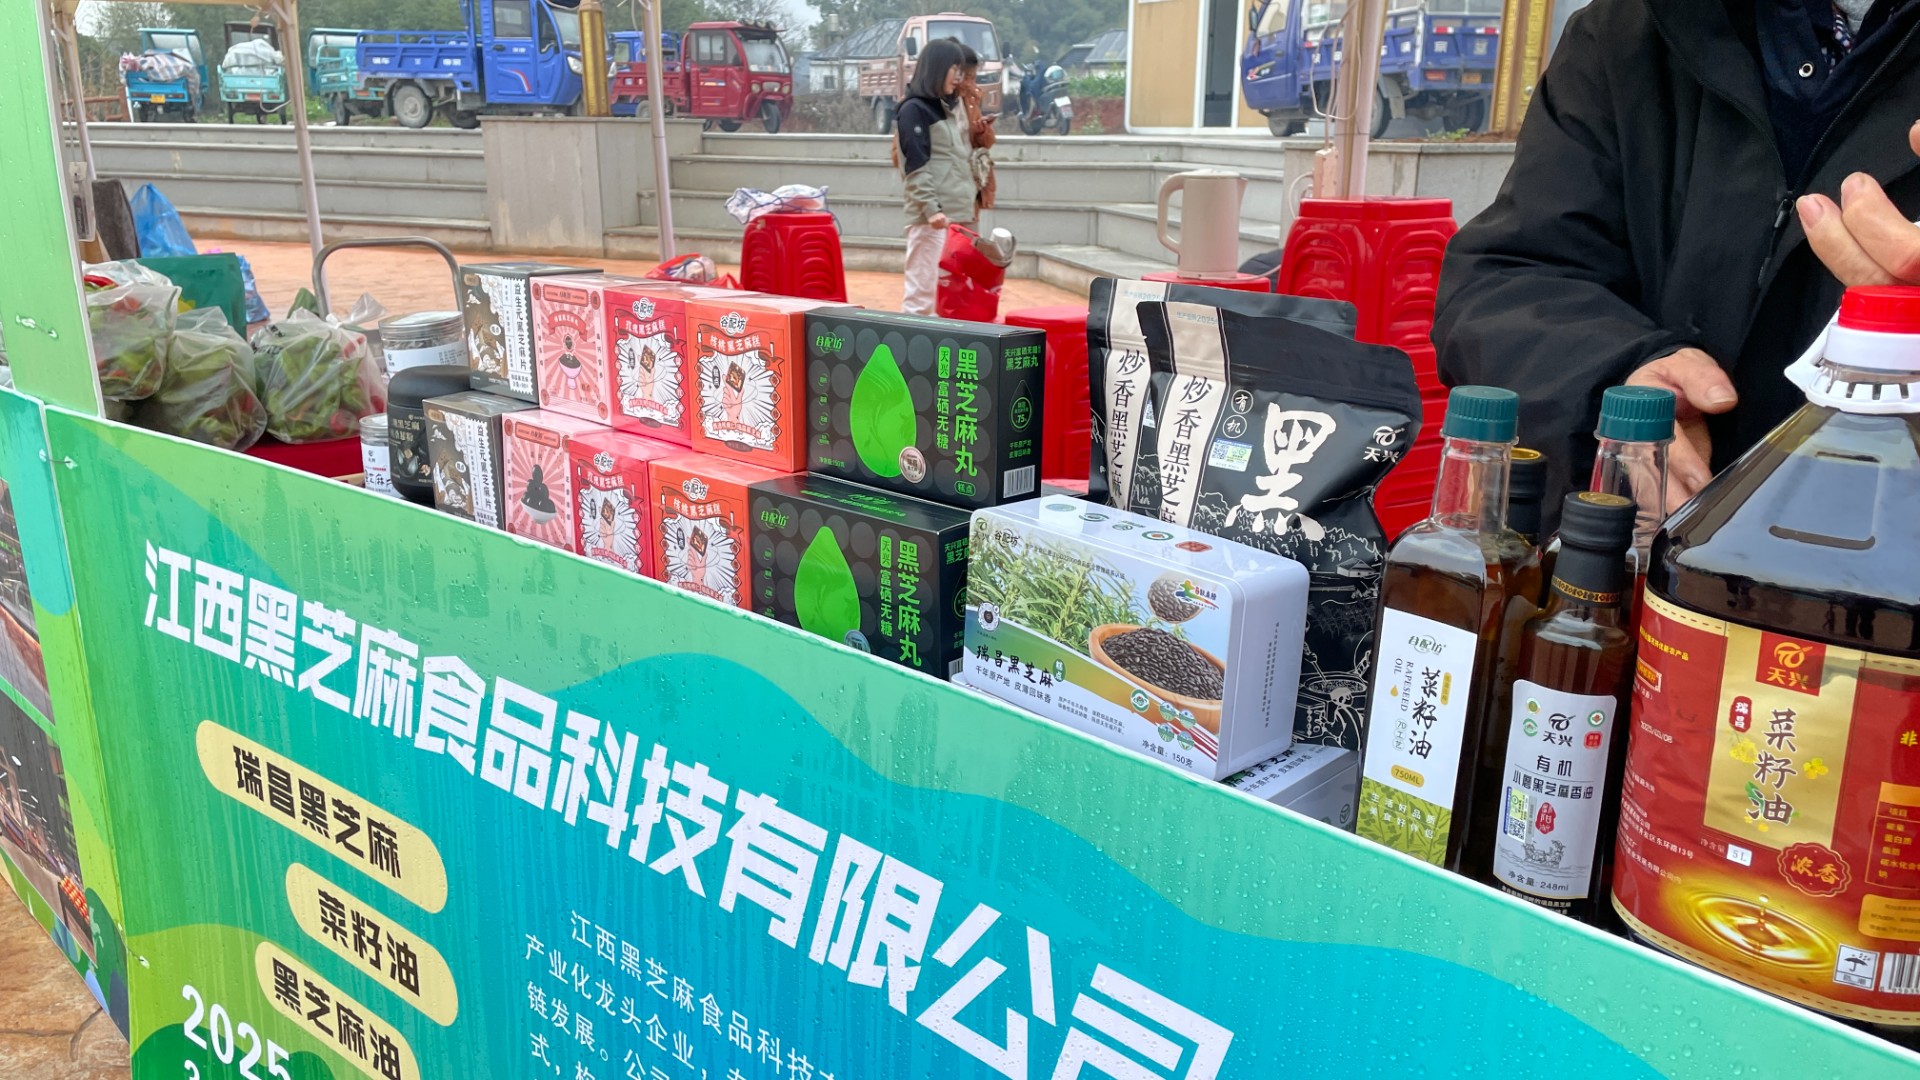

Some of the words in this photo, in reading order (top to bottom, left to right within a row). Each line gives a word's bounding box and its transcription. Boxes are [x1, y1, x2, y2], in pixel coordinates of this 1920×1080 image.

[633, 301, 654, 315] 谷配坊
[514, 283, 527, 371] 益生元黑芝麻片
[625, 319, 667, 335] 玫瑰黑芝麻糕
[720, 315, 746, 331] 谷配坊
[709, 334, 761, 352] 核桃黑芝麻糕
[816, 335, 842, 350] 谷配坊
[940, 349, 949, 375] 天兴
[1006, 355, 1038, 371] 黑芝麻丸
[937, 381, 949, 449] 富硒无糖
[954, 349, 978, 477] 黑芝麻丸
[593, 453, 613, 468] 谷配坊
[1363, 447, 1399, 463] 天兴
[477, 425, 493, 509] 益生元黑芝麻片
[1225, 402, 1337, 541] 黑
[587, 471, 624, 489] 玫瑰黑芝麻糕
[682, 480, 707, 497] 谷配坊
[957, 482, 974, 494] 糕点
[673, 498, 722, 516] 核桃黑芝麻糕
[760, 510, 787, 527] 谷配坊
[994, 530, 1018, 546] 谷配坊
[881, 538, 891, 566] 天兴
[880, 569, 893, 637] 富硒无糖
[898, 540, 922, 667] 黑芝麻丸
[1408, 635, 1443, 655] 谷配坊
[975, 665, 1010, 687] 千年原产地
[976, 644, 1054, 688] 瑞昌黑芝麻
[1393, 657, 1403, 675] OIL
[1401, 661, 1414, 712] RAPESEED
[1767, 667, 1808, 690] 天兴
[1014, 681, 1051, 704] 皮薄回味香
[1408, 666, 1441, 760] 菜籽油
[1735, 701, 1749, 729] 瑞昌
[1542, 731, 1573, 748] 天兴
[1900, 730, 1918, 747] 非
[1172, 752, 1193, 768] 150克
[1537, 755, 1572, 777] 有机
[1747, 708, 1798, 825] 菜籽油
[1394, 768, 1421, 785] 750ML
[1512, 769, 1594, 800] 小磨黑芝麻香油
[145, 539, 1234, 1080] 江西黑芝麻食品科技有限公司
[233, 745, 402, 878] 瑞昌黑芝麻
[1370, 793, 1436, 825] 生活好品质
[1732, 850, 1748, 862] 5L
[1791, 855, 1840, 885] 浓香
[1540, 881, 1569, 891] 248ml
[318, 889, 420, 997] 菜籽油
[570, 909, 834, 1080] 江西黑芝麻食品科技
[272, 956, 402, 1080] 黑芝麻油
[525, 933, 747, 1080] 产业化龙头企业，
[182, 984, 290, 1080] 2025
